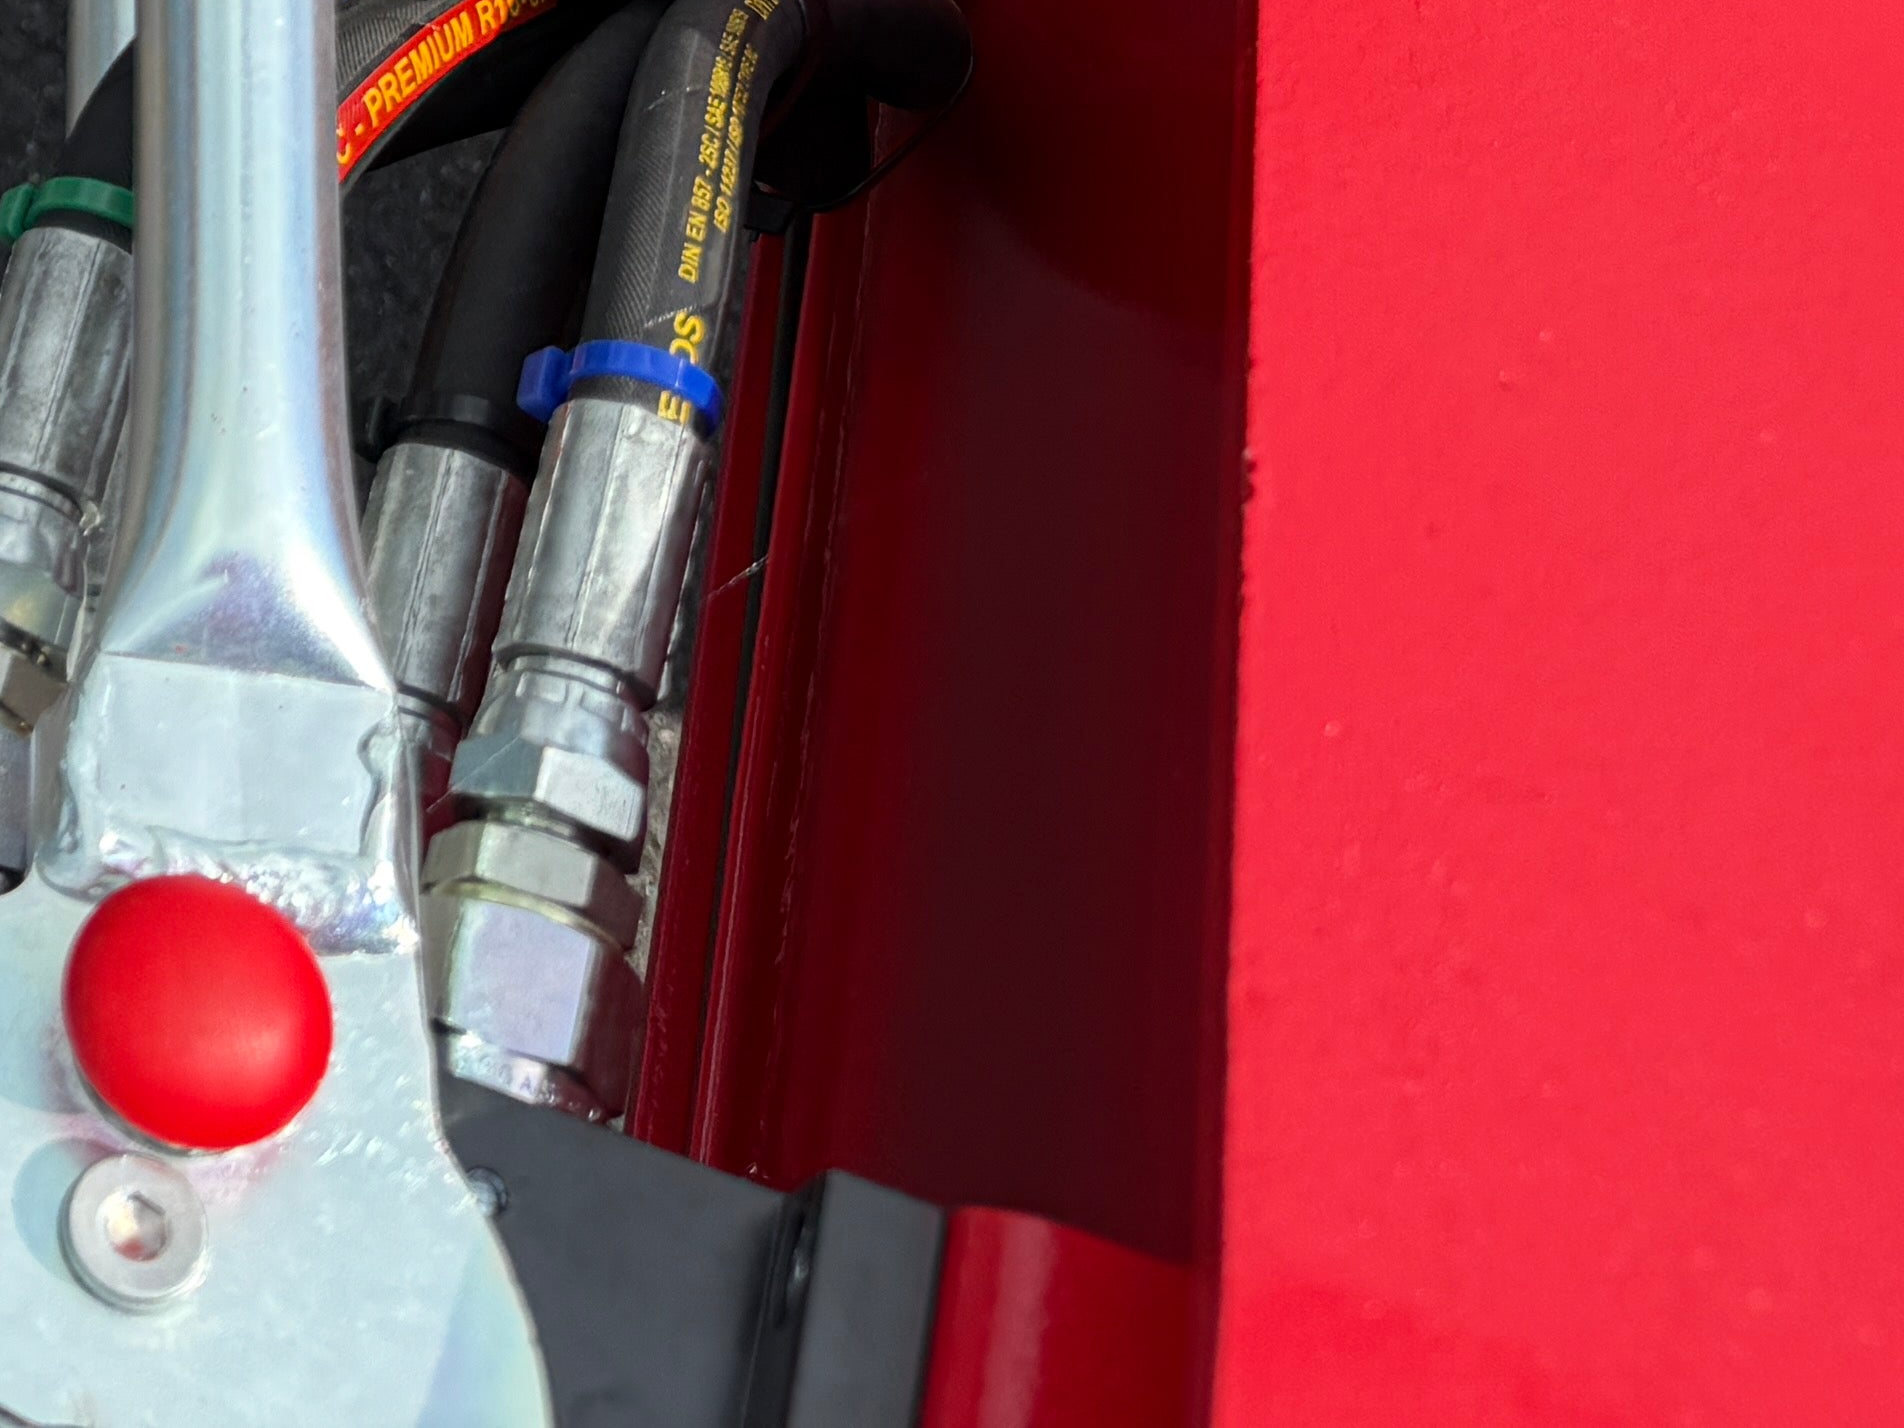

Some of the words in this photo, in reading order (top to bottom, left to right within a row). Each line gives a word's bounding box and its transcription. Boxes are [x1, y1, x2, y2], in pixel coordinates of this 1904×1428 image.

[361, 10, 474, 128] PREMIUM
[689, 175, 714, 211] 857
[685, 211, 708, 242] EN
[677, 243, 704, 284] DIN
